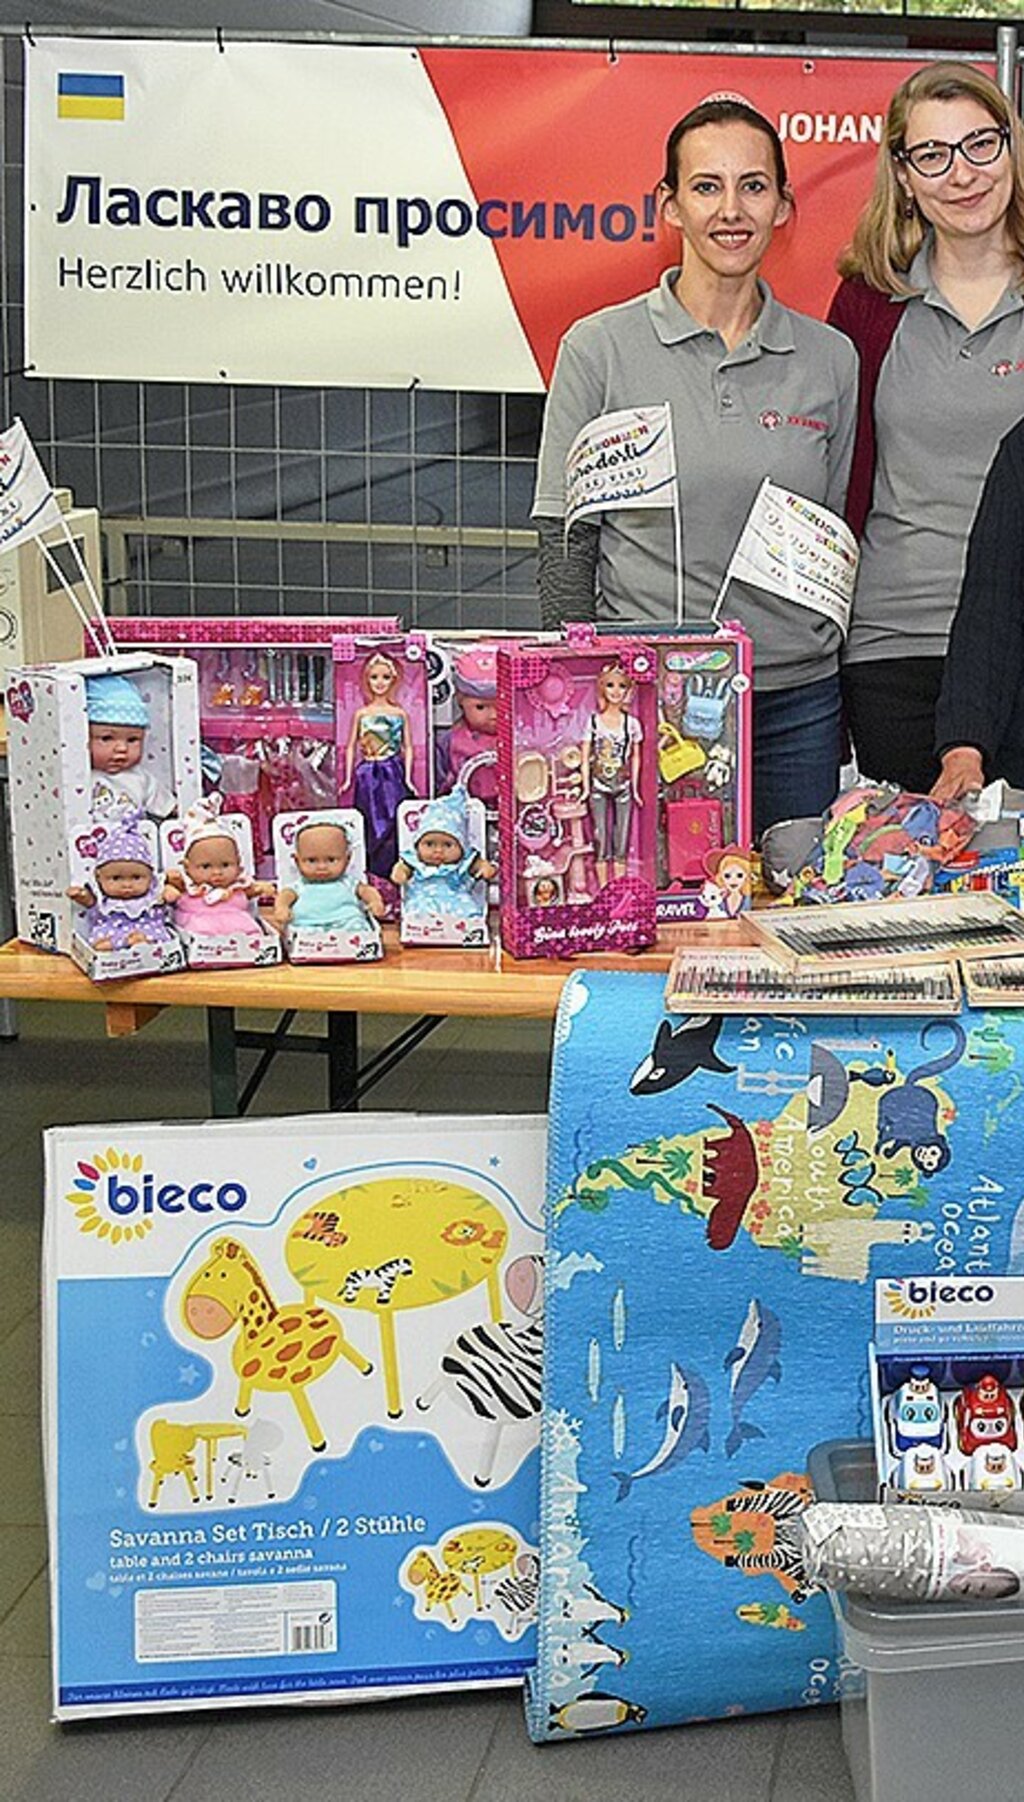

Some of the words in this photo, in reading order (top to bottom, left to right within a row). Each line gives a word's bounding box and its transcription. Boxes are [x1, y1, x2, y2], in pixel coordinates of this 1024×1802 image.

[778, 112, 883, 143] JOHAN
[57, 175, 332, 233] Ласкаво
[354, 193, 656, 248] просимо!
[57, 258, 207, 292] Herzlich
[221, 262, 462, 301] willkommen!
[656, 902, 696, 917] RAVEL
[106, 1174, 249, 1216] bieco
[772, 1111, 807, 1238] America
[934, 1202, 964, 1273] Ocea
[964, 1174, 1006, 1274] Atlant
[908, 1280, 995, 1304] bieco
[109, 1528, 207, 1548] Savanna
[211, 1524, 247, 1544] Set
[252, 1519, 315, 1541] Tisch
[320, 1517, 332, 1538] /
[335, 1518, 350, 1537] 2
[354, 1514, 427, 1537] Stühle
[109, 1554, 149, 1569] table
[150, 1551, 181, 1568] and
[182, 1552, 195, 1566] 2
[196, 1549, 246, 1565] chairs
[248, 1548, 314, 1562] savanna
[801, 1658, 831, 1705] Oce
